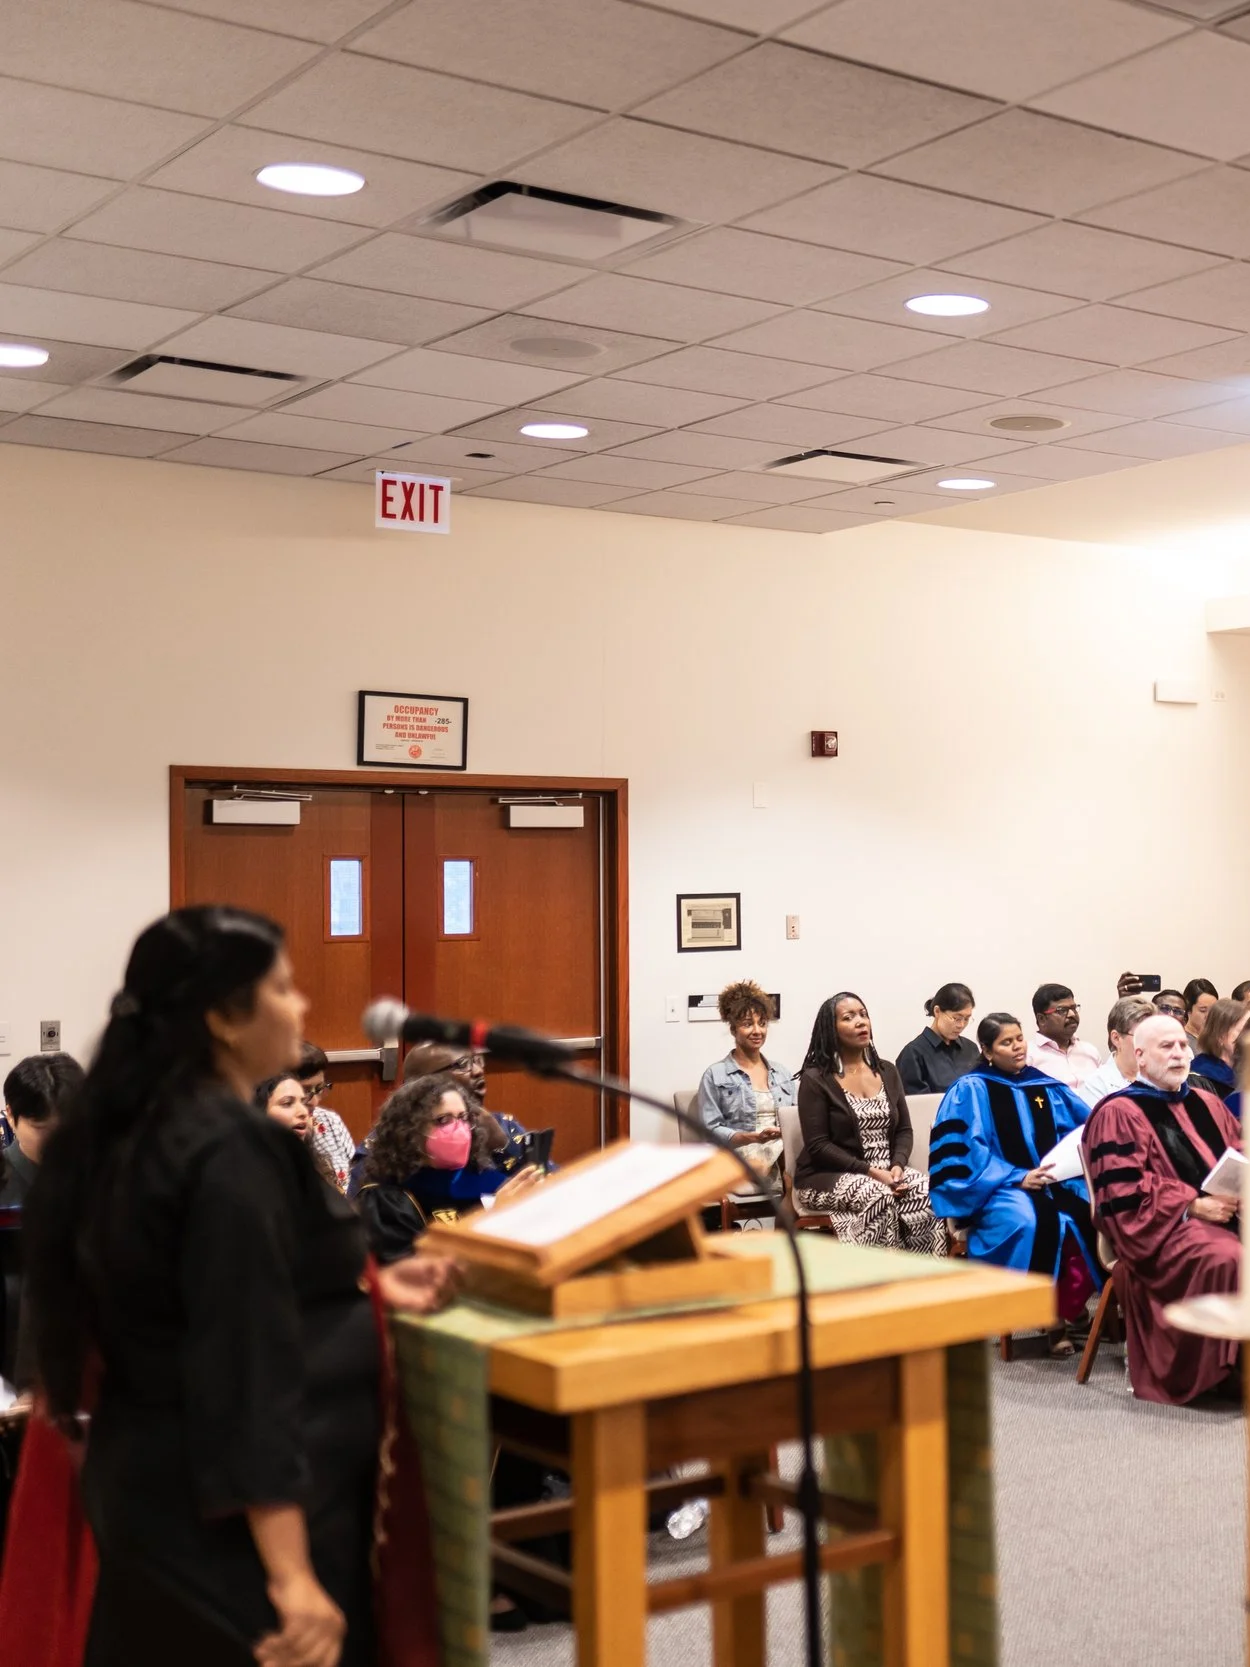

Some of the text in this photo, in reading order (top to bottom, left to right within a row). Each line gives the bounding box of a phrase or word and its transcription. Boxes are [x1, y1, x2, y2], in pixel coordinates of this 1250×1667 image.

[382, 479, 443, 523] EXIT
[394, 704, 439, 716] OCCUPANCY
[416, 725, 449, 733] DANGEROUS
